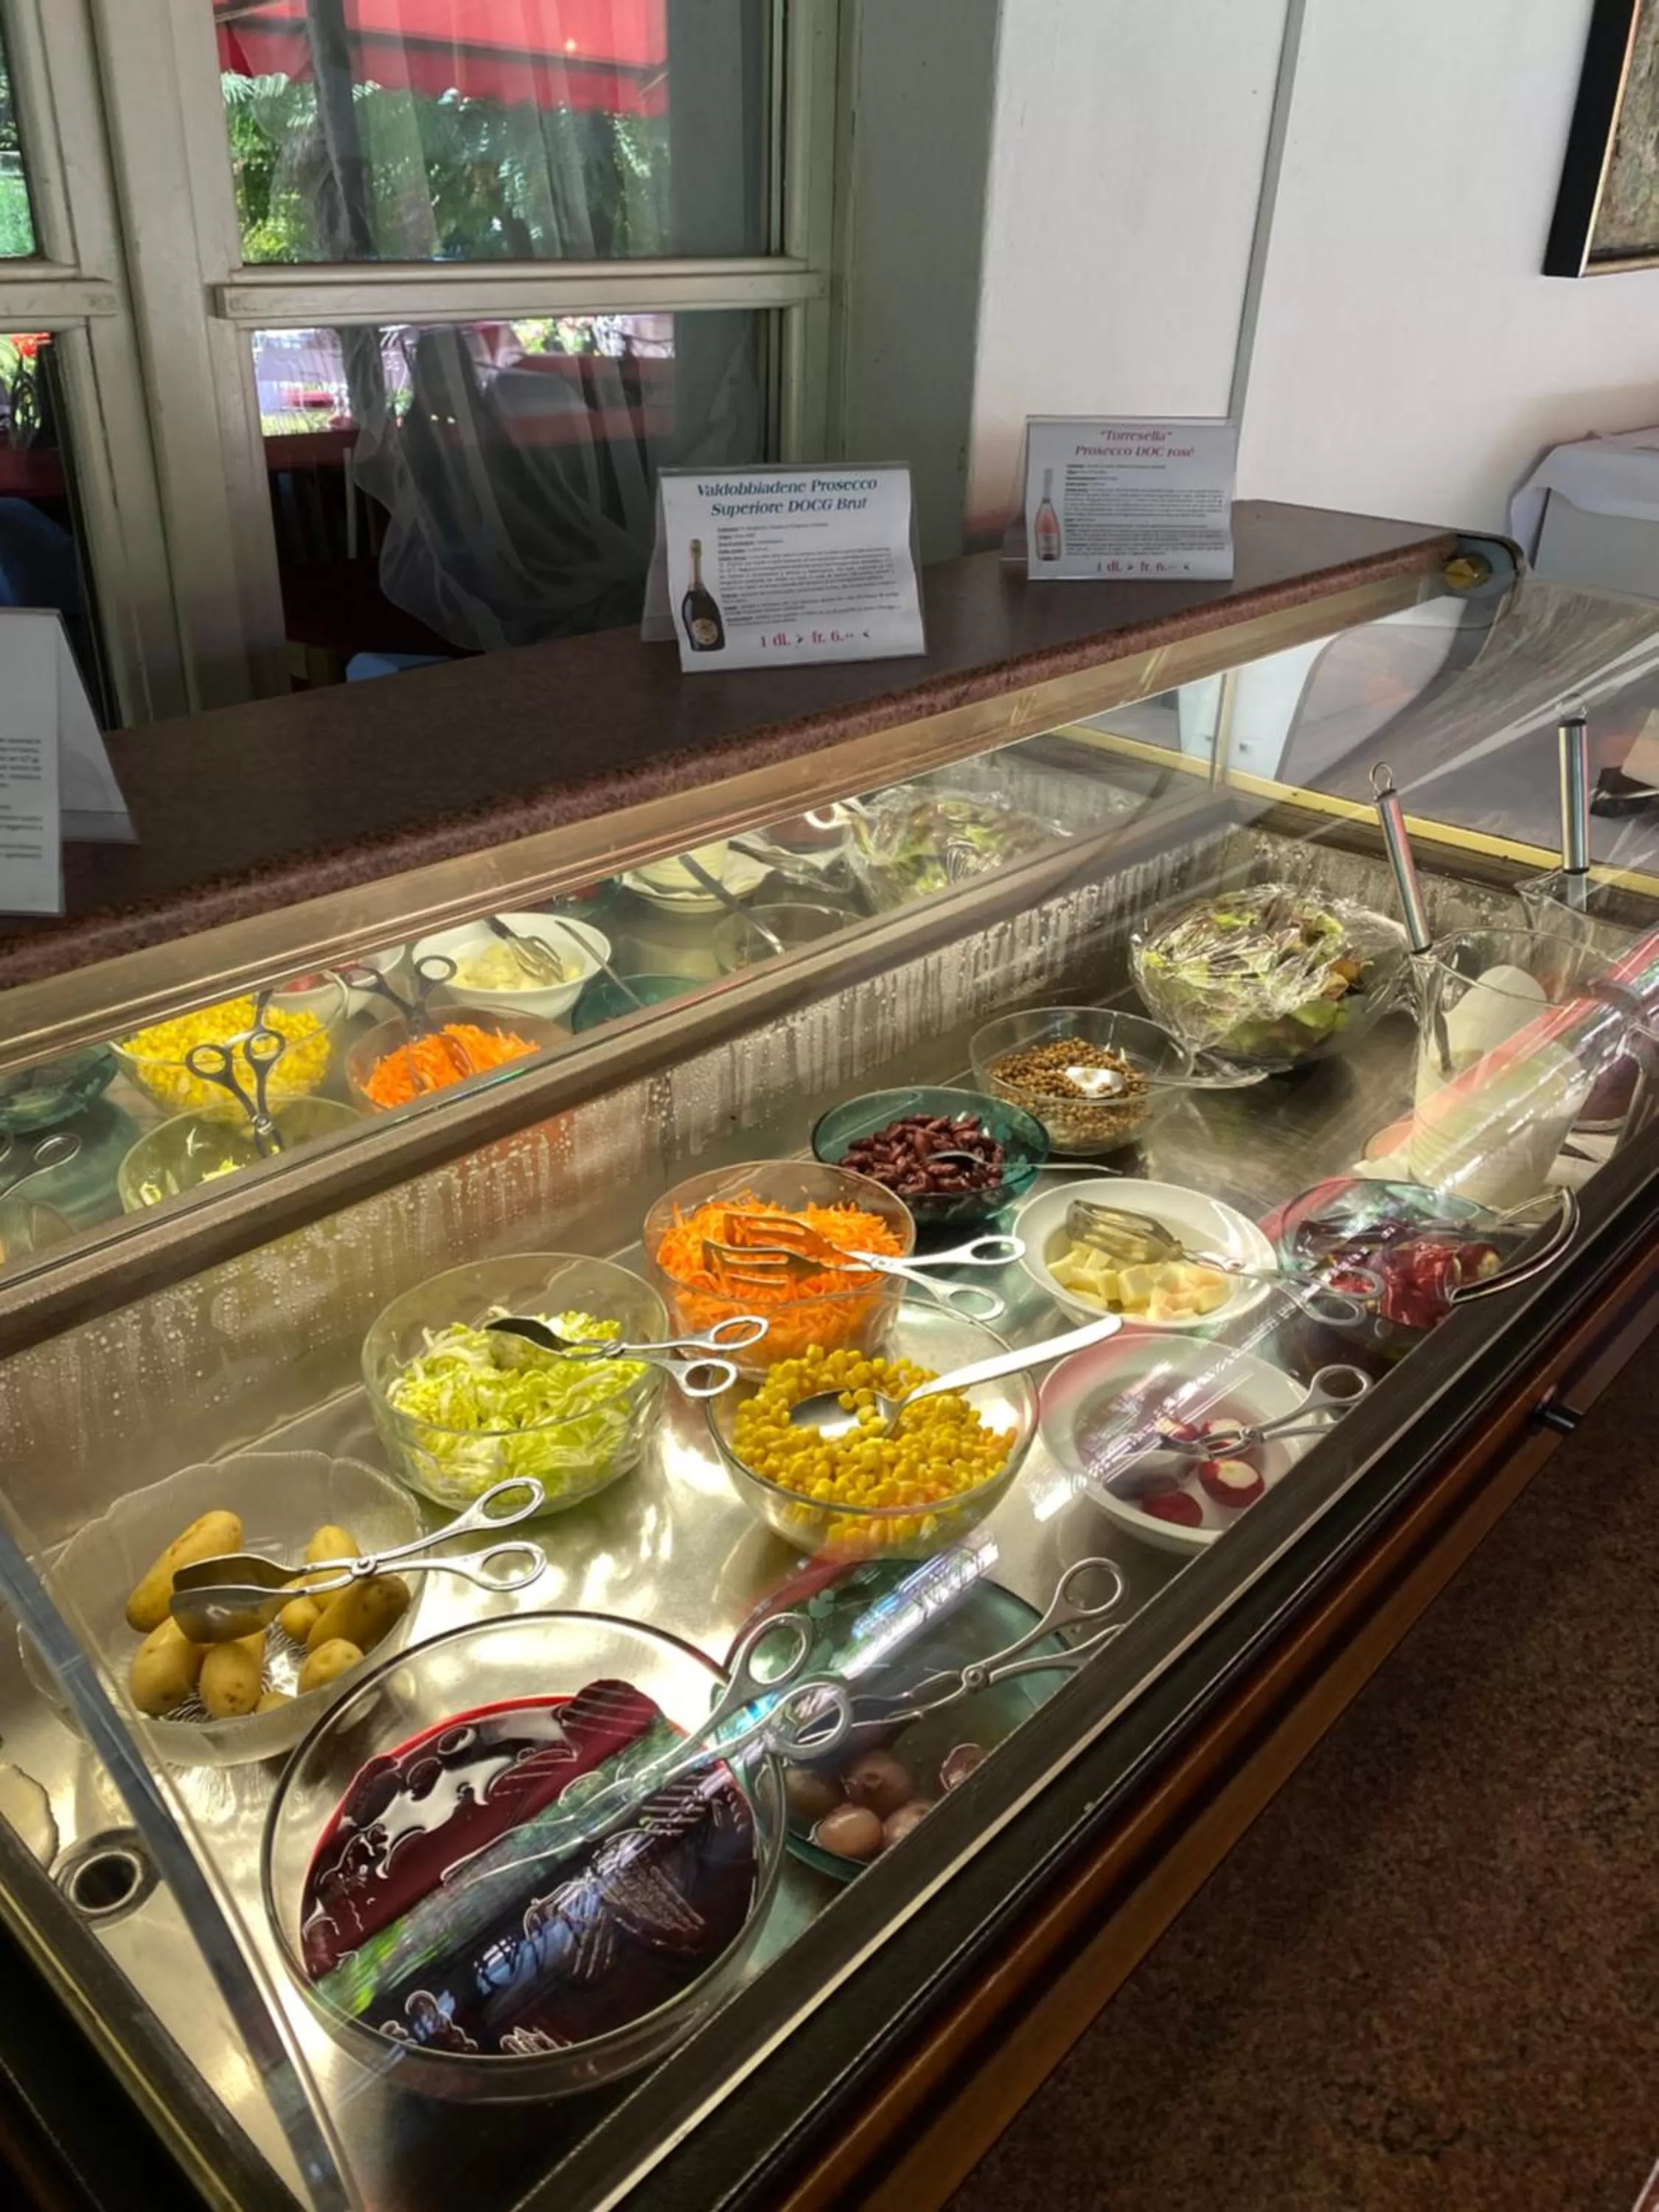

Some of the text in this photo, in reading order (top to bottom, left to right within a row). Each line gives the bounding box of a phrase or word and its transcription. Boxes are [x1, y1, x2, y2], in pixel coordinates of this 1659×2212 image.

[1074, 445, 1133, 457] Prosecco
[697, 477, 878, 498] Valdobbiadene Prosecco
[710, 496, 868, 518] Superiore DOCG Brut
